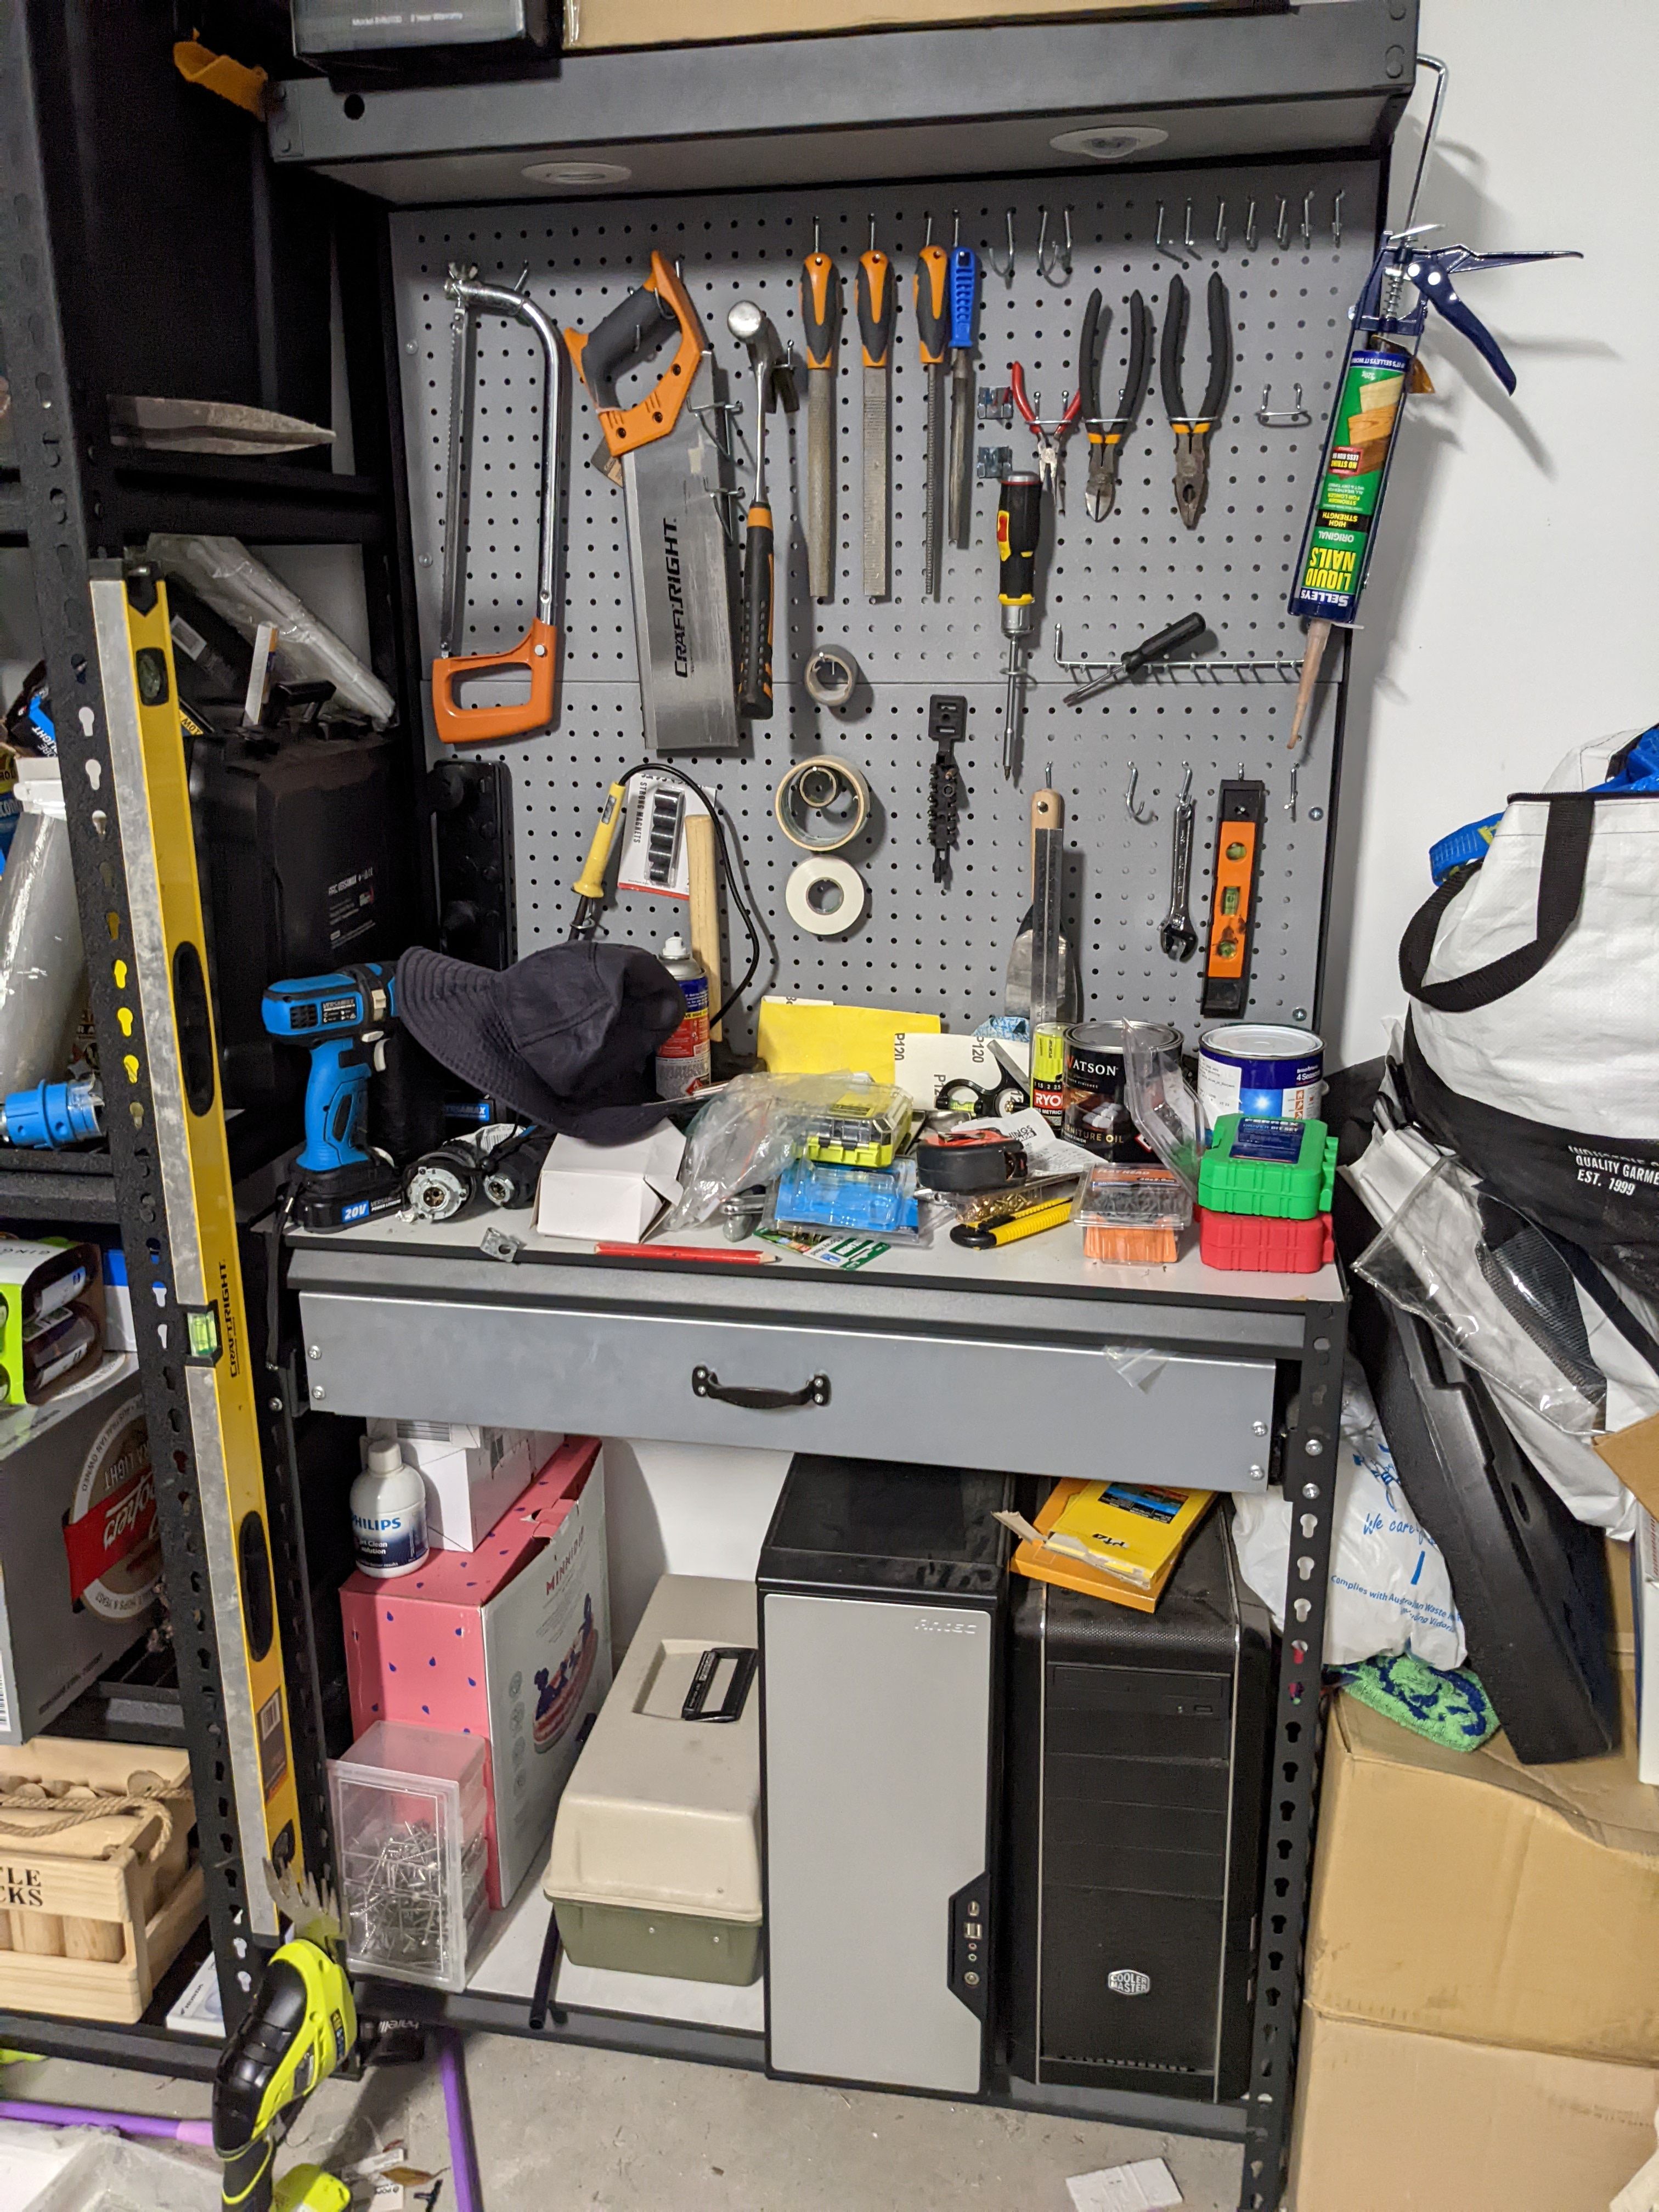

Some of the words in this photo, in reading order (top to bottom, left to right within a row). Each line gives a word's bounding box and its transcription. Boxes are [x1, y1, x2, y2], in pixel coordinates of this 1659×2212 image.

[1322, 511, 1358, 522] STRENGTH
[1328, 520, 1346, 528] HIGH
[1318, 531, 1355, 543] ORIGINAL
[1310, 547, 1356, 572] NAILS
[1305, 568, 1352, 591] LIQUID
[663, 517, 688, 678] CRAFTRIGHT
[1301, 589, 1350, 607] SELLEYS
[637, 781, 647, 810] STRONG
[633, 811, 644, 844] MAGNETS
[1035, 1092, 1063, 1108] RYO
[1105, 1135, 1124, 1143] OIL
[1576, 1154, 1620, 1175] QUALITY
[1577, 1169, 1602, 1187] EST.
[1609, 1177, 1636, 1196] 1999
[344, 1204, 367, 1220] 20V
[219, 1261, 238, 1378] CRAFTRIGHT
[105, 1454, 134, 1491] LIGHT
[1363, 1513, 1384, 1536] We
[1389, 1519, 1415, 1534] care
[1331, 1574, 1368, 1595] Complies
[1369, 1588, 1390, 1602] with
[0, 1866, 41, 1887] LE
[1110, 1972, 1147, 1984] COOLER
[1110, 1980, 1147, 1993] MASTER
